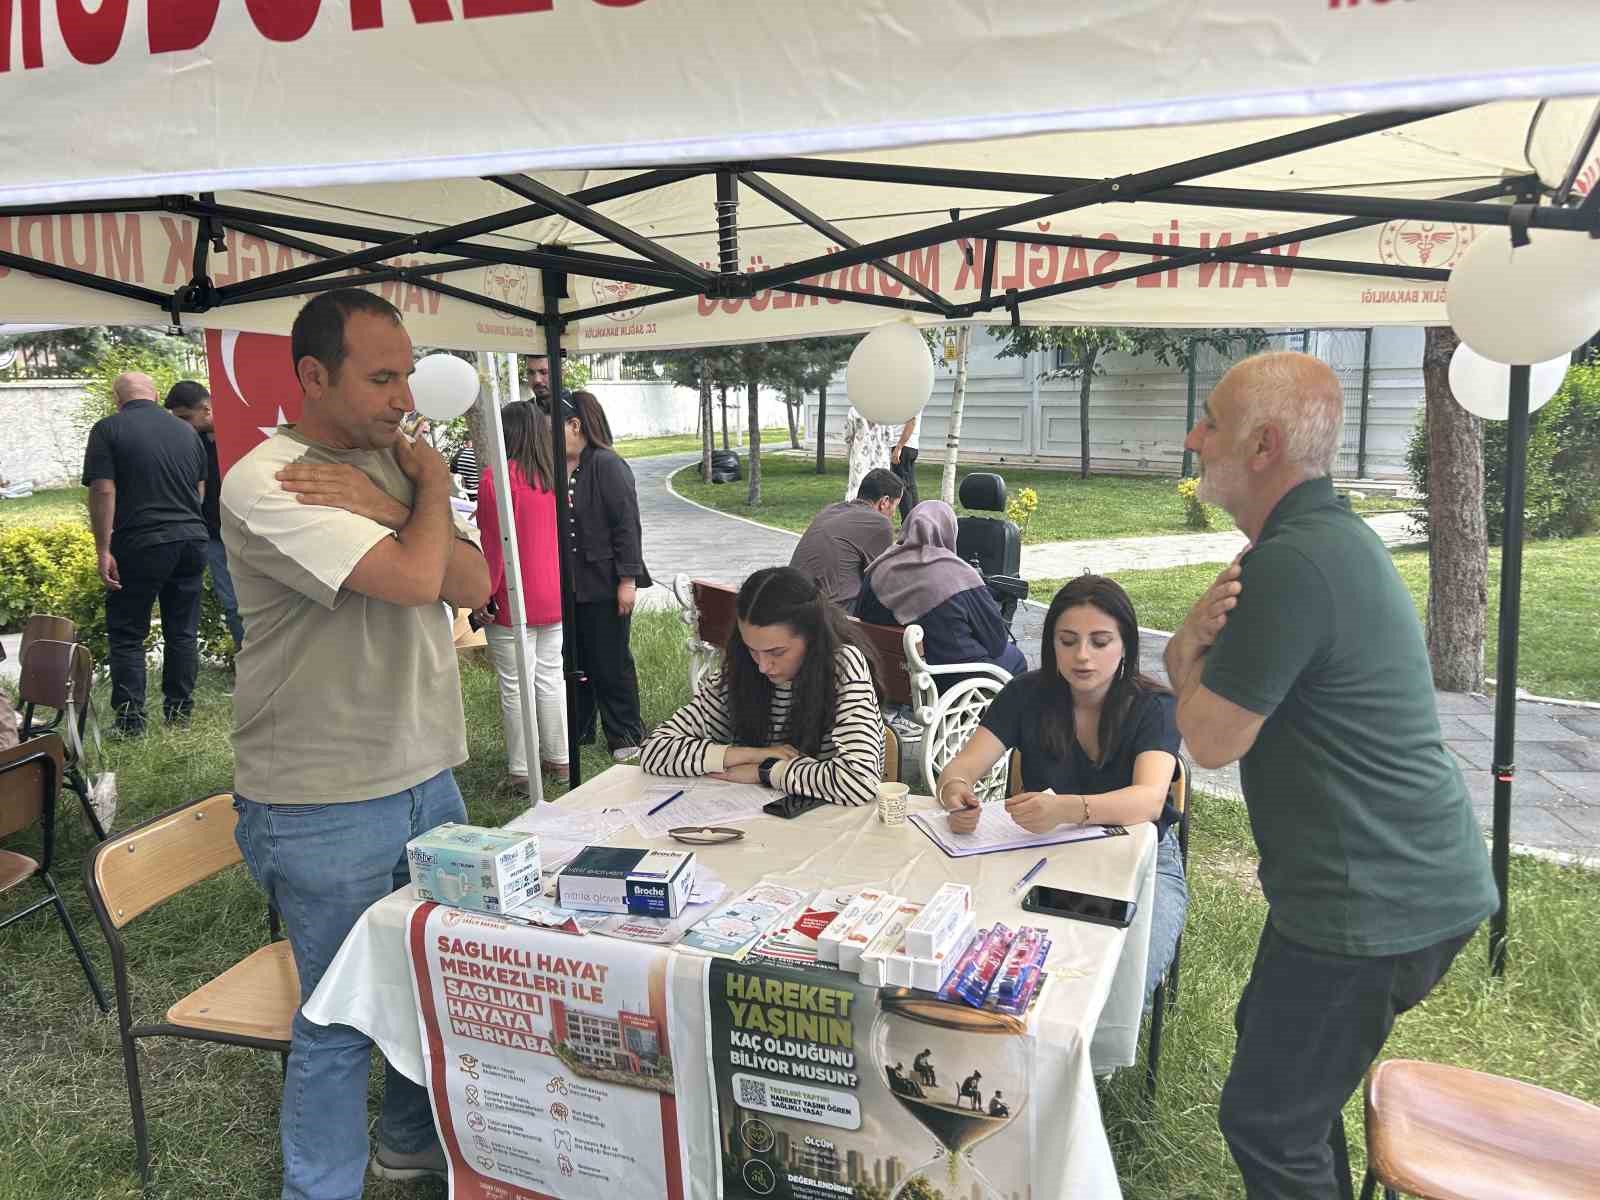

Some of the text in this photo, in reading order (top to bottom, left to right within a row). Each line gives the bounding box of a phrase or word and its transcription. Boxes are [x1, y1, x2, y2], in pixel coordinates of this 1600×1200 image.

[440, 957, 604, 1004] MERKEZLERİ İLE
[537, 953, 609, 984] HAYAT
[726, 973, 854, 1017] HAREKET
[450, 1000, 530, 1032] HAYATA
[727, 1000, 854, 1048] YAŞININ
[453, 1019, 553, 1053] MERHABA
[730, 1030, 854, 1068] KAÇ OLDUĞUNU
[730, 1050, 858, 1087] BİLİYOR MUSUN?
